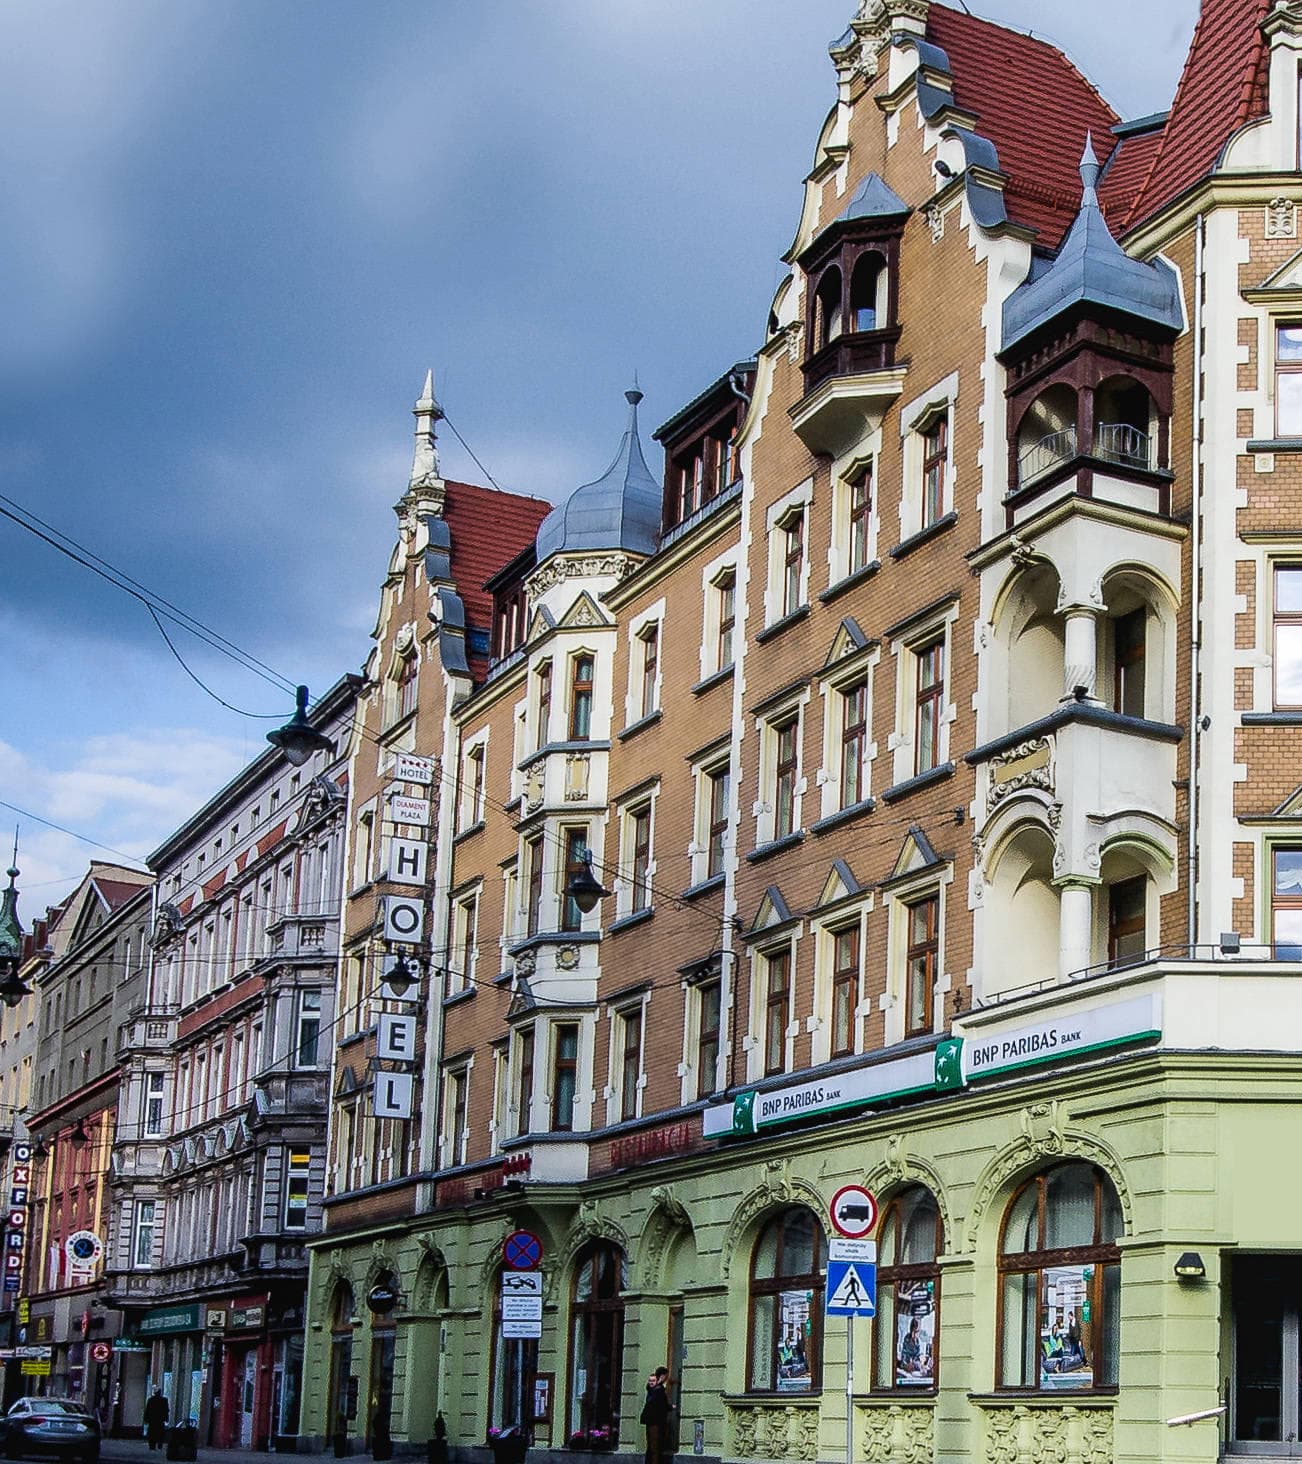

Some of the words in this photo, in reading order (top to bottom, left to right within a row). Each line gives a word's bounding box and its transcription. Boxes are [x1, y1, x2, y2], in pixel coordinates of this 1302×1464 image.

[400, 767, 428, 780] HOTEL
[396, 800, 426, 811] DIAMENT
[400, 811, 421, 820] PLAZA
[386, 846, 420, 1109] HOEL
[973, 1045, 999, 1066] BNP
[1002, 1029, 1057, 1059] PARIBAS
[1061, 1030, 1081, 1044] BANK
[762, 1098, 782, 1117] BNP
[783, 1087, 824, 1111] PARIBAS
[826, 1090, 841, 1101] BANK
[8, 1147, 30, 1268] OXFORD
